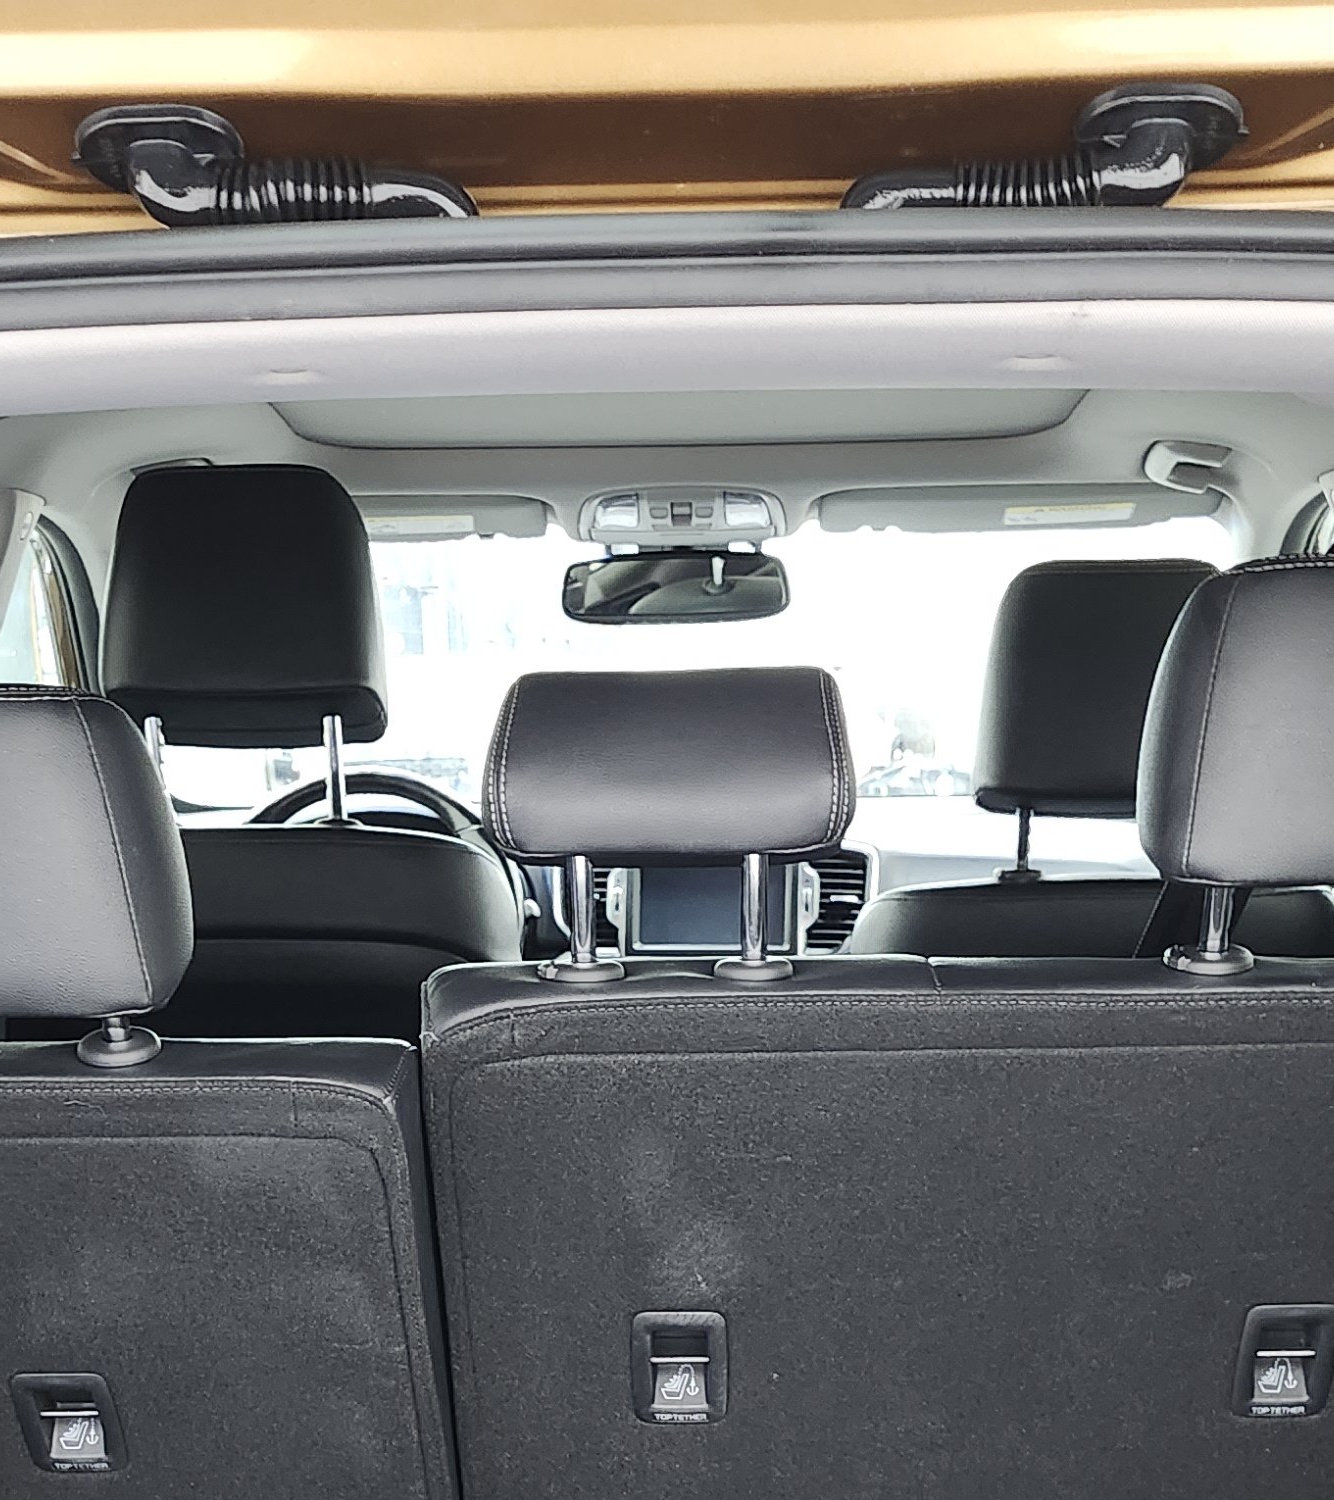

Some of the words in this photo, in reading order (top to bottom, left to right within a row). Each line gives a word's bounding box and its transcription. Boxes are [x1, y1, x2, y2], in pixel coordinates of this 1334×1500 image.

[1251, 1406, 1270, 1415] TOP
[654, 1413, 672, 1421] TOP
[54, 1462, 73, 1471] TOP
